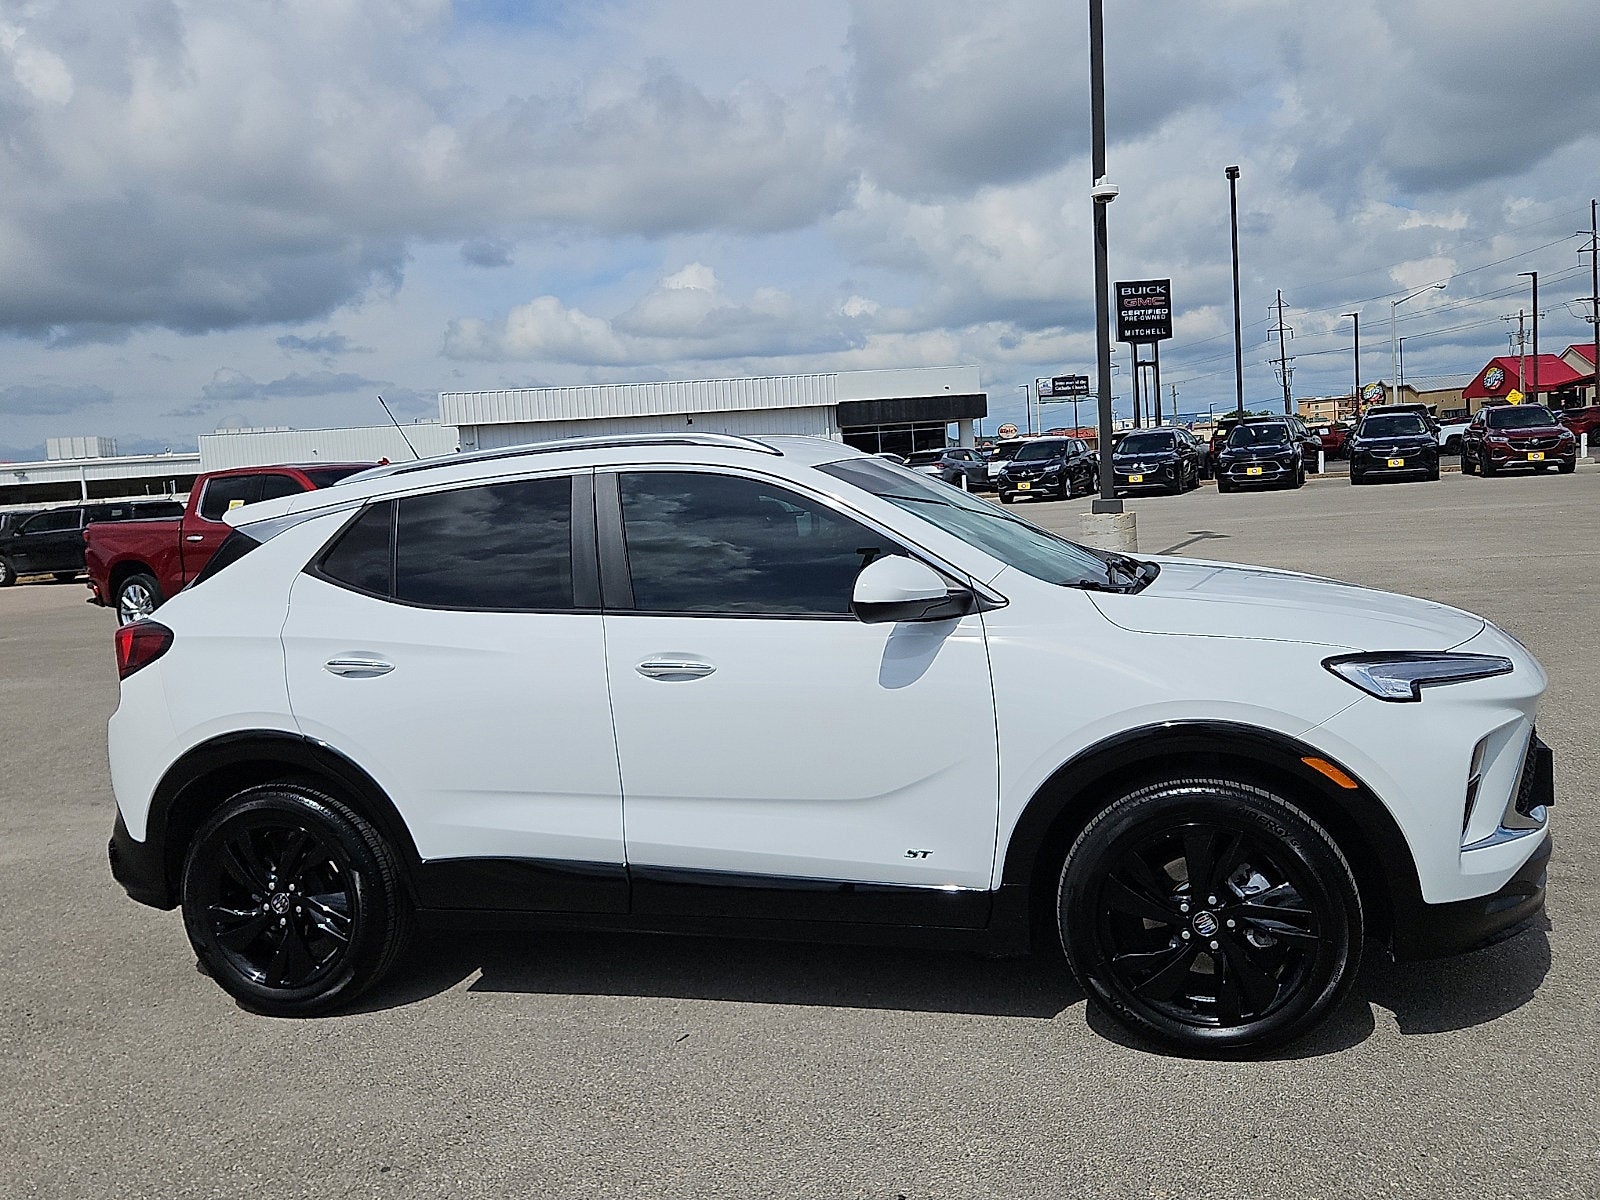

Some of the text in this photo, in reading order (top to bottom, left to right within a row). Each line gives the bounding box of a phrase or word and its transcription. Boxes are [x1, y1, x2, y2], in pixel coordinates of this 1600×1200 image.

[1121, 286, 1167, 295] BUICK
[1123, 296, 1165, 307] GMC
[1124, 328, 1166, 336] MITCHELL
[904, 850, 933, 858] ST
